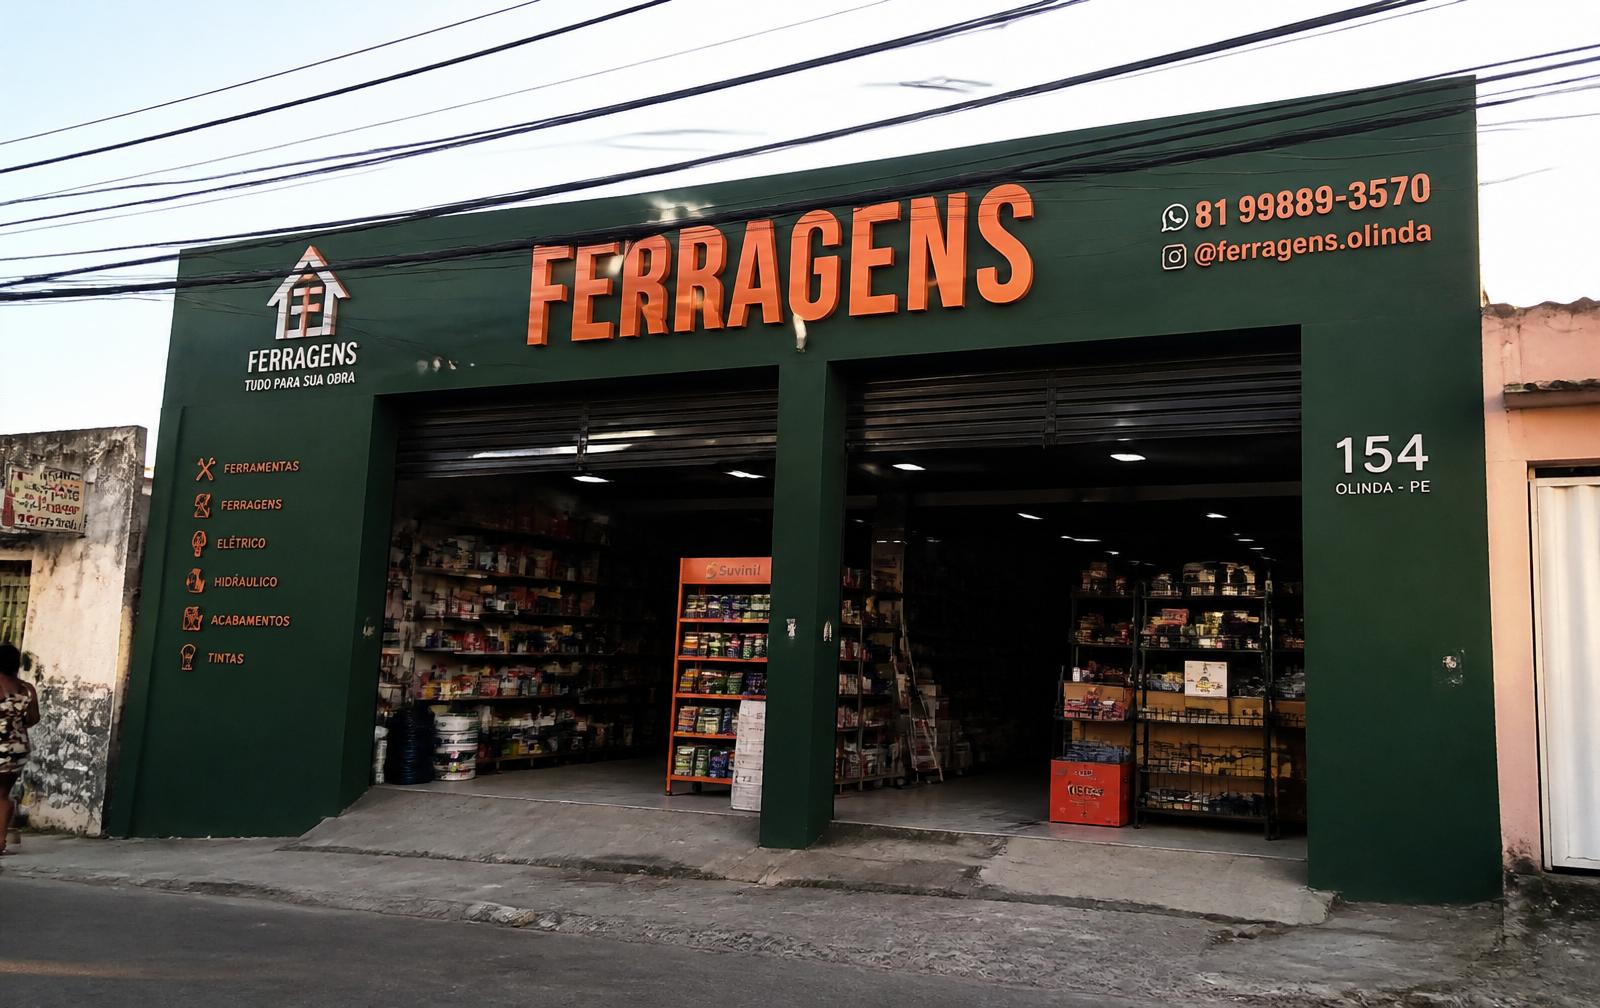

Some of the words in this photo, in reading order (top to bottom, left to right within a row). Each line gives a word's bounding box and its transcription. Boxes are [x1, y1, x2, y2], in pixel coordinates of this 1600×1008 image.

[1194, 198, 1228, 229] 81
[1238, 172, 1431, 224] 99889-3570
[1194, 219, 1432, 266] @ferragens.olinda
[526, 183, 1035, 347] FERRAGENS
[247, 341, 358, 373] FERRAGENS
[245, 378, 272, 392] TUDO
[273, 376, 300, 389] PARA
[303, 374, 324, 387] SUA
[327, 371, 355, 385] OBRA
[1336, 433, 1429, 474] 154
[223, 460, 300, 474] FERRAMENTAS
[1335, 481, 1394, 495] OLINDA
[1410, 480, 1431, 493] PE
[221, 499, 283, 511] FERRAGENS
[217, 535, 266, 549] ELÉTRICO
[719, 564, 761, 577] Suvinil
[211, 614, 291, 627] ACABAMENTOS
[207, 652, 244, 664] TINTAS
